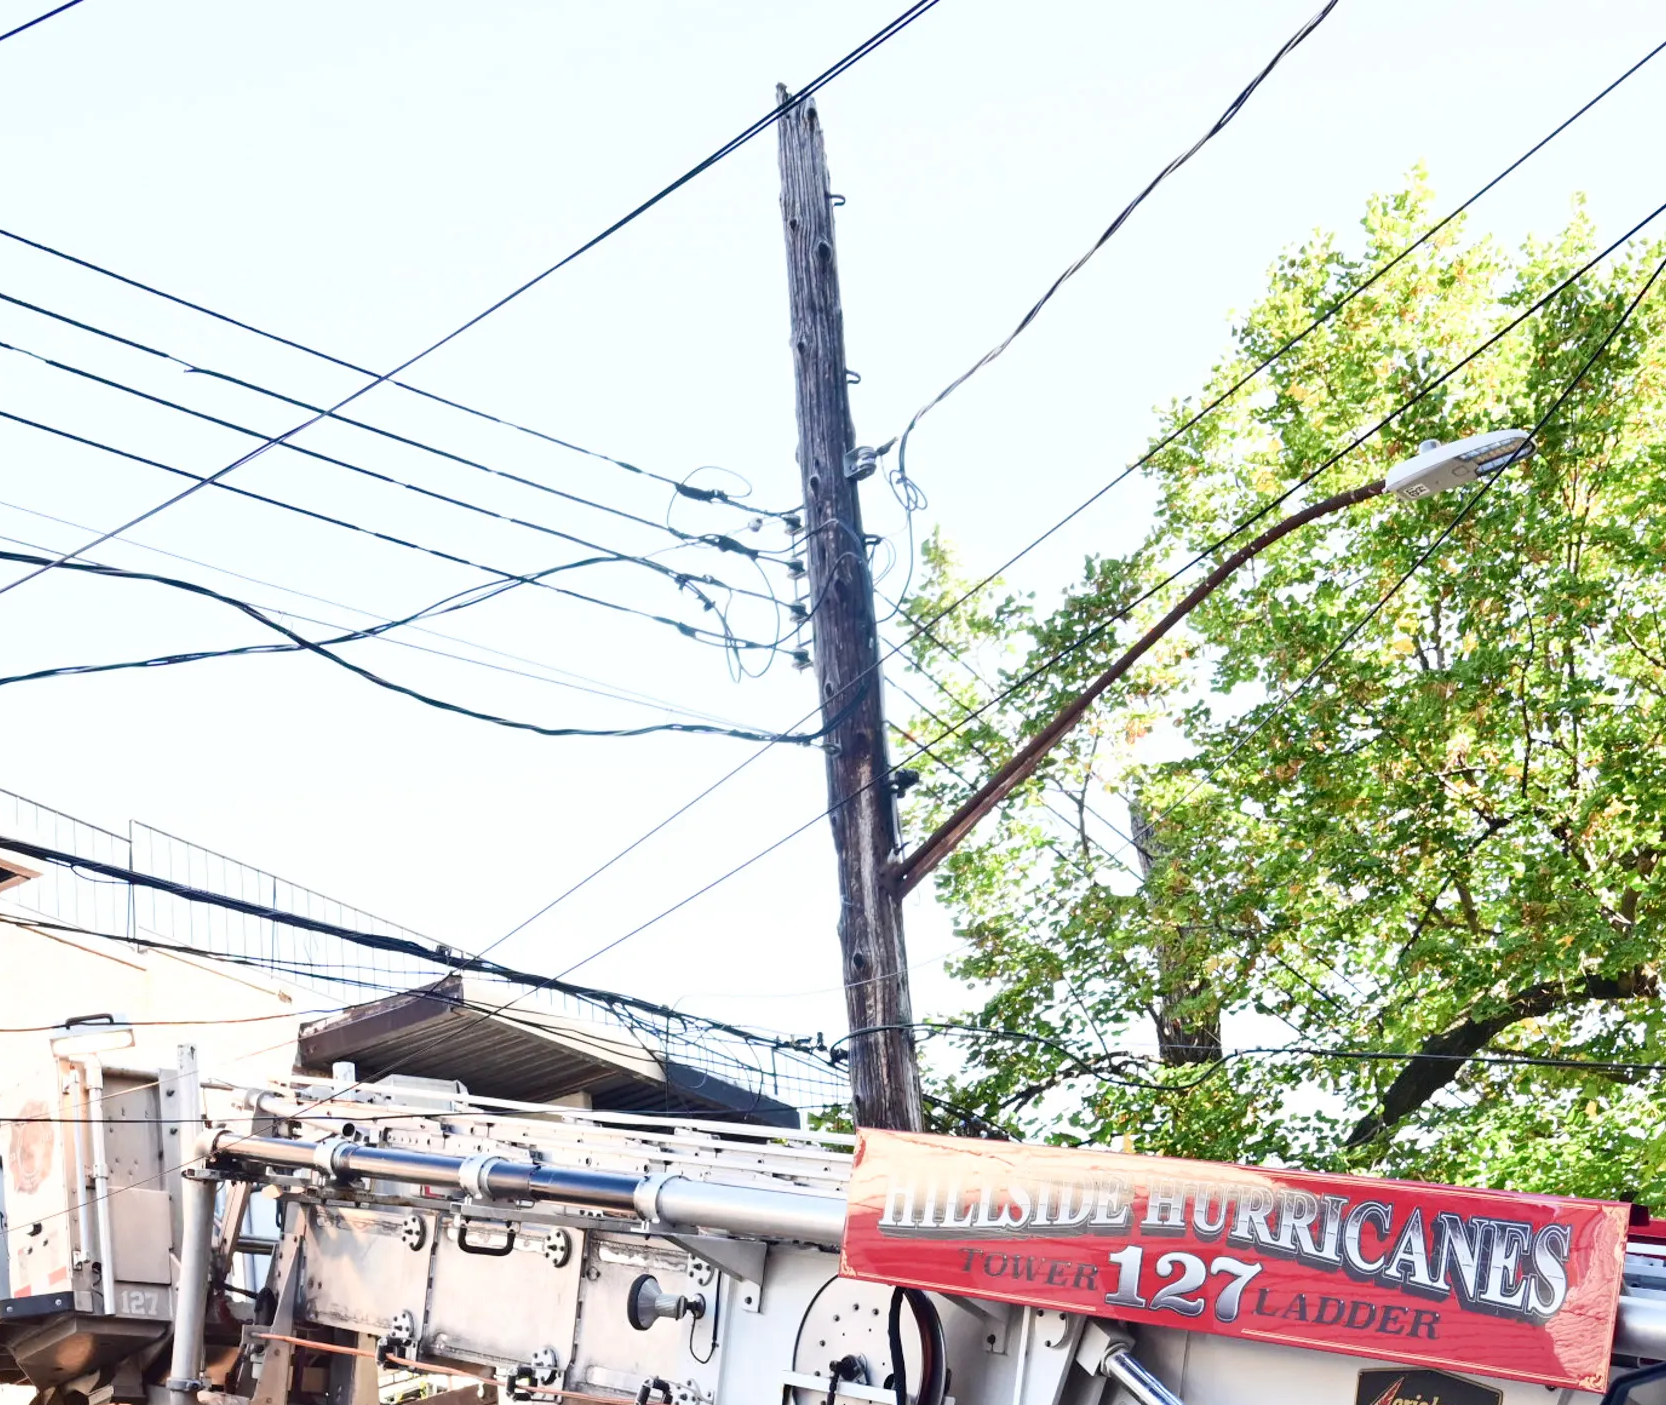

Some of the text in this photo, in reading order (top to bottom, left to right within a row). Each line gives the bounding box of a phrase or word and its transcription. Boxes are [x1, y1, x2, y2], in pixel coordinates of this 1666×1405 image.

[878, 1172, 1572, 1322] HILLSIDE HURRICANES
[960, 1245, 1442, 1339] TOWER 127 LADDER
[120, 1290, 159, 1316] 127
